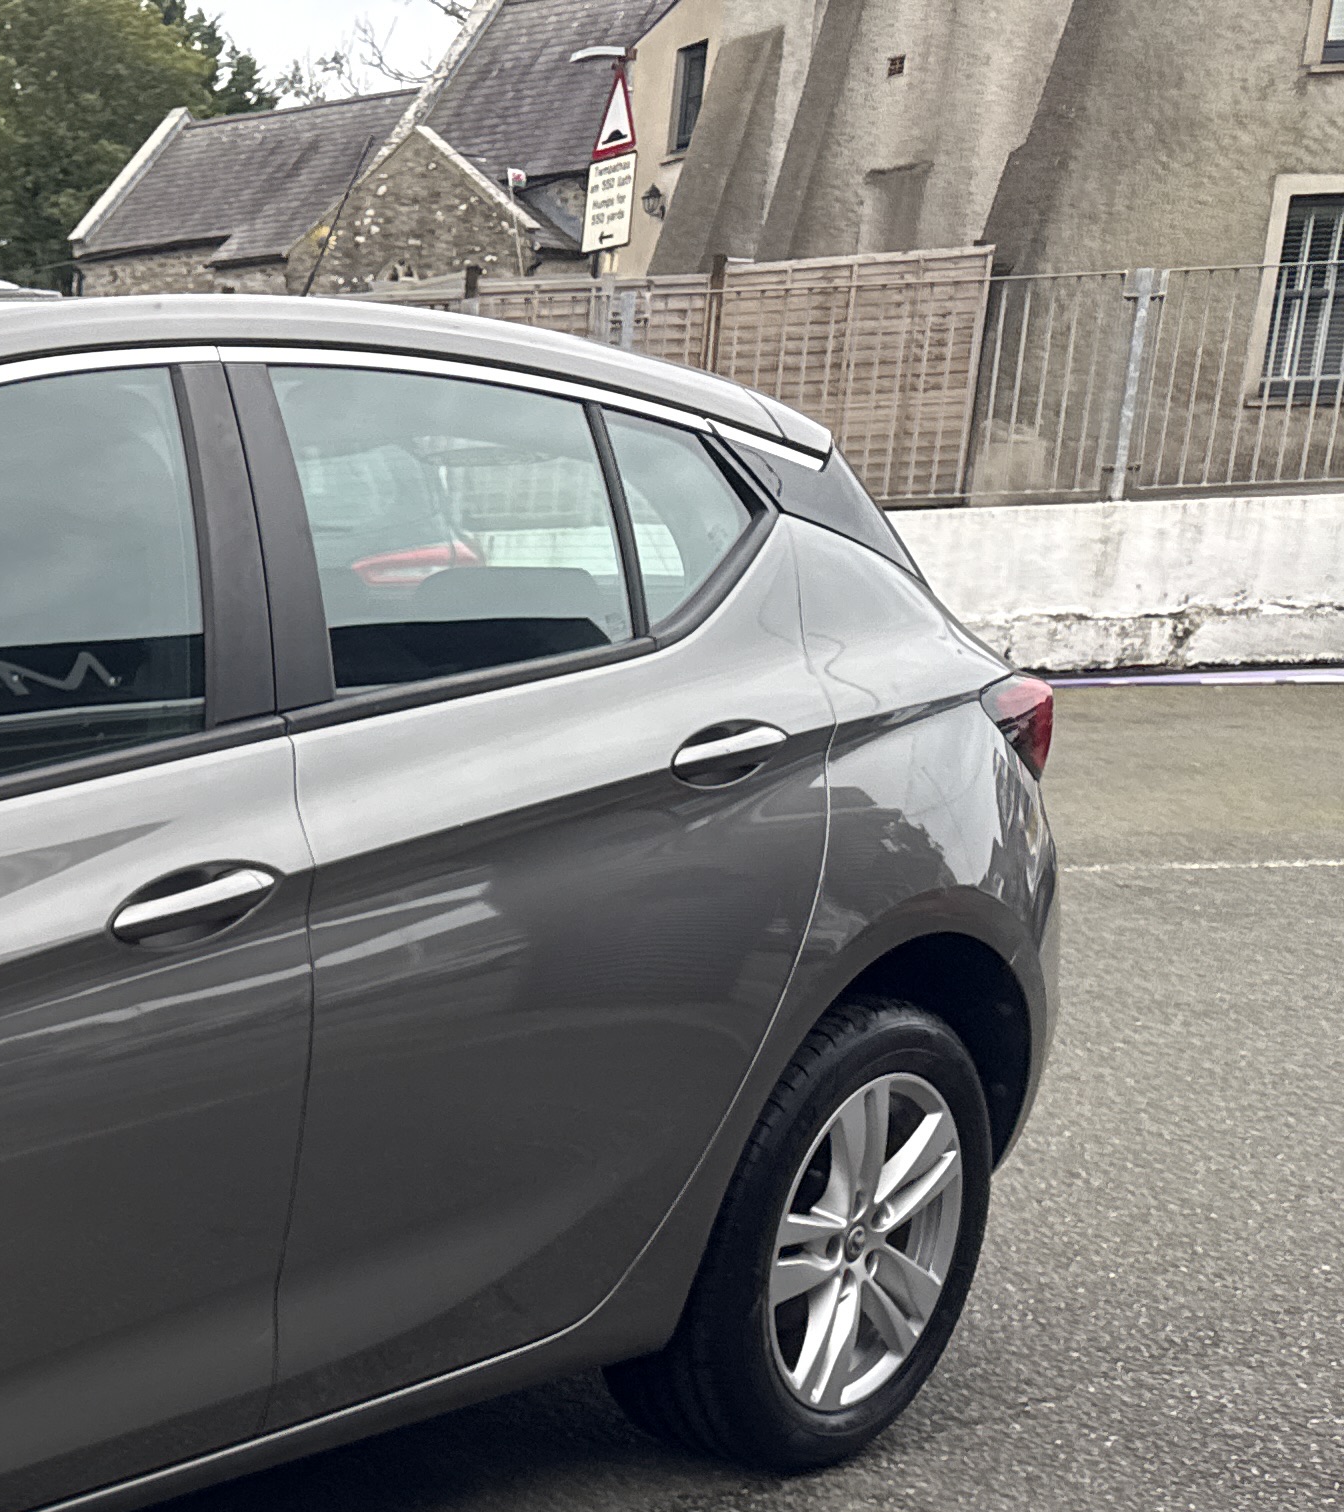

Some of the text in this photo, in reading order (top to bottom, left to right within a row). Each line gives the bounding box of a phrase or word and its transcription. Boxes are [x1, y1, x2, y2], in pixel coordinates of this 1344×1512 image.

[602, 178, 615, 191] 550
[592, 193, 626, 210] Humps for
[591, 209, 625, 226] 550 yards
